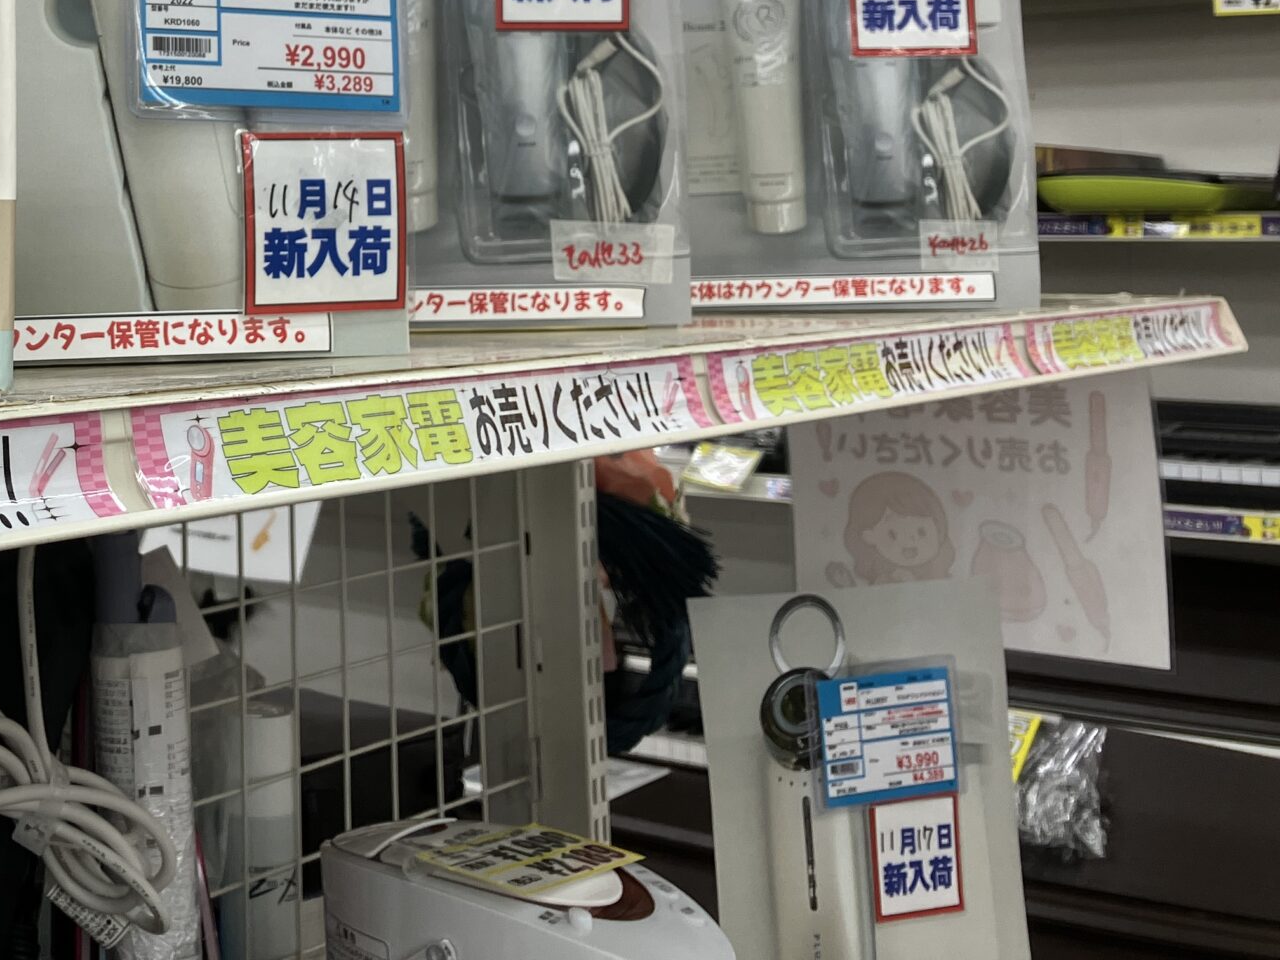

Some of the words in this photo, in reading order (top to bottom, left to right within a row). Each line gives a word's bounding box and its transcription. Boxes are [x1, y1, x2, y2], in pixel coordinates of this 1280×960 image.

[232, 38, 251, 47] Price
[285, 43, 366, 72] ¥2,990
[162, 74, 203, 88] ¥19,800
[314, 73, 374, 94] ¥3,289
[267, 178, 392, 224] 11月14日
[263, 226, 392, 278] 新入荷
[895, 750, 940, 770] ¥3,990
[880, 823, 952, 856] 11月17日
[883, 855, 953, 897] 新入荷
